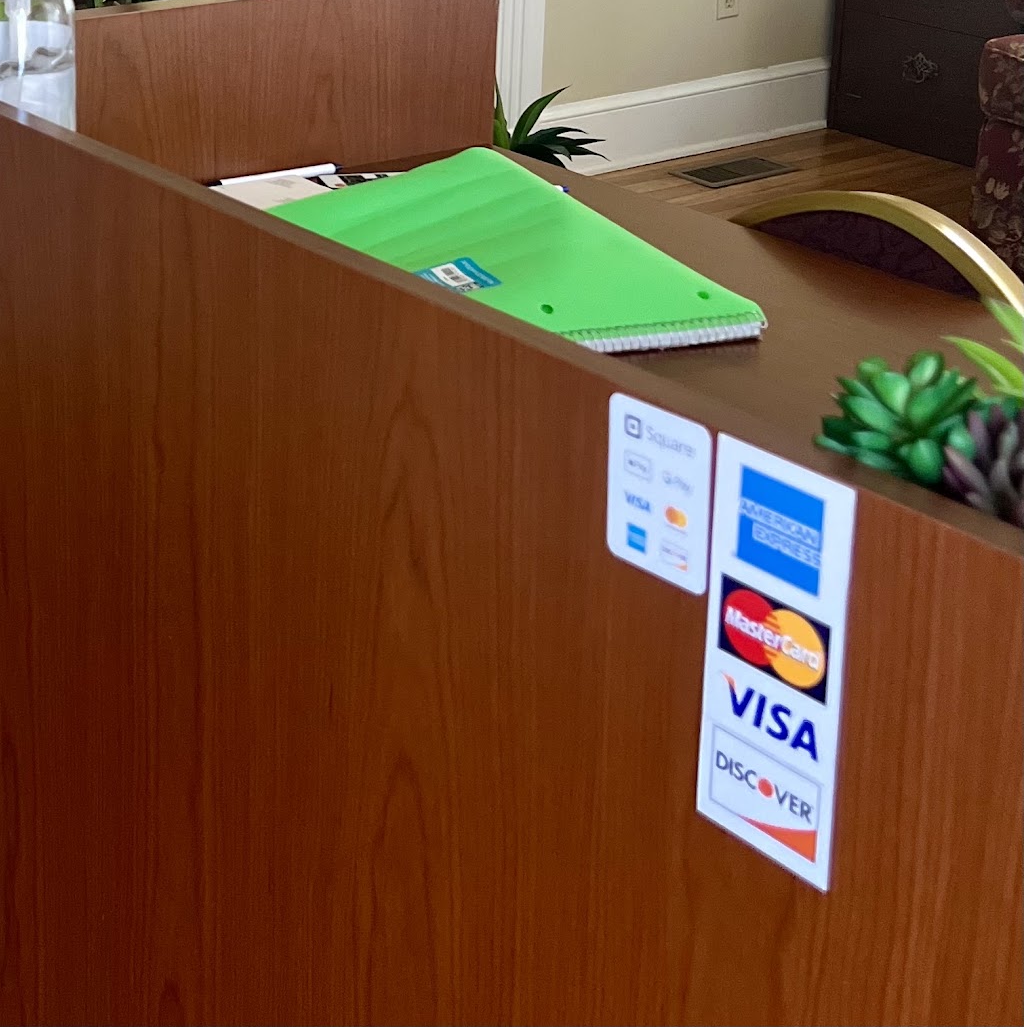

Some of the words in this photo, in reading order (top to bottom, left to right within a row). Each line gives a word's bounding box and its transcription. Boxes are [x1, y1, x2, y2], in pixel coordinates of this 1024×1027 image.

[645, 425, 696, 459] Square
[724, 604, 820, 672] MasterCard
[723, 672, 818, 762] VISA
[715, 749, 813, 825] DISCOVER
